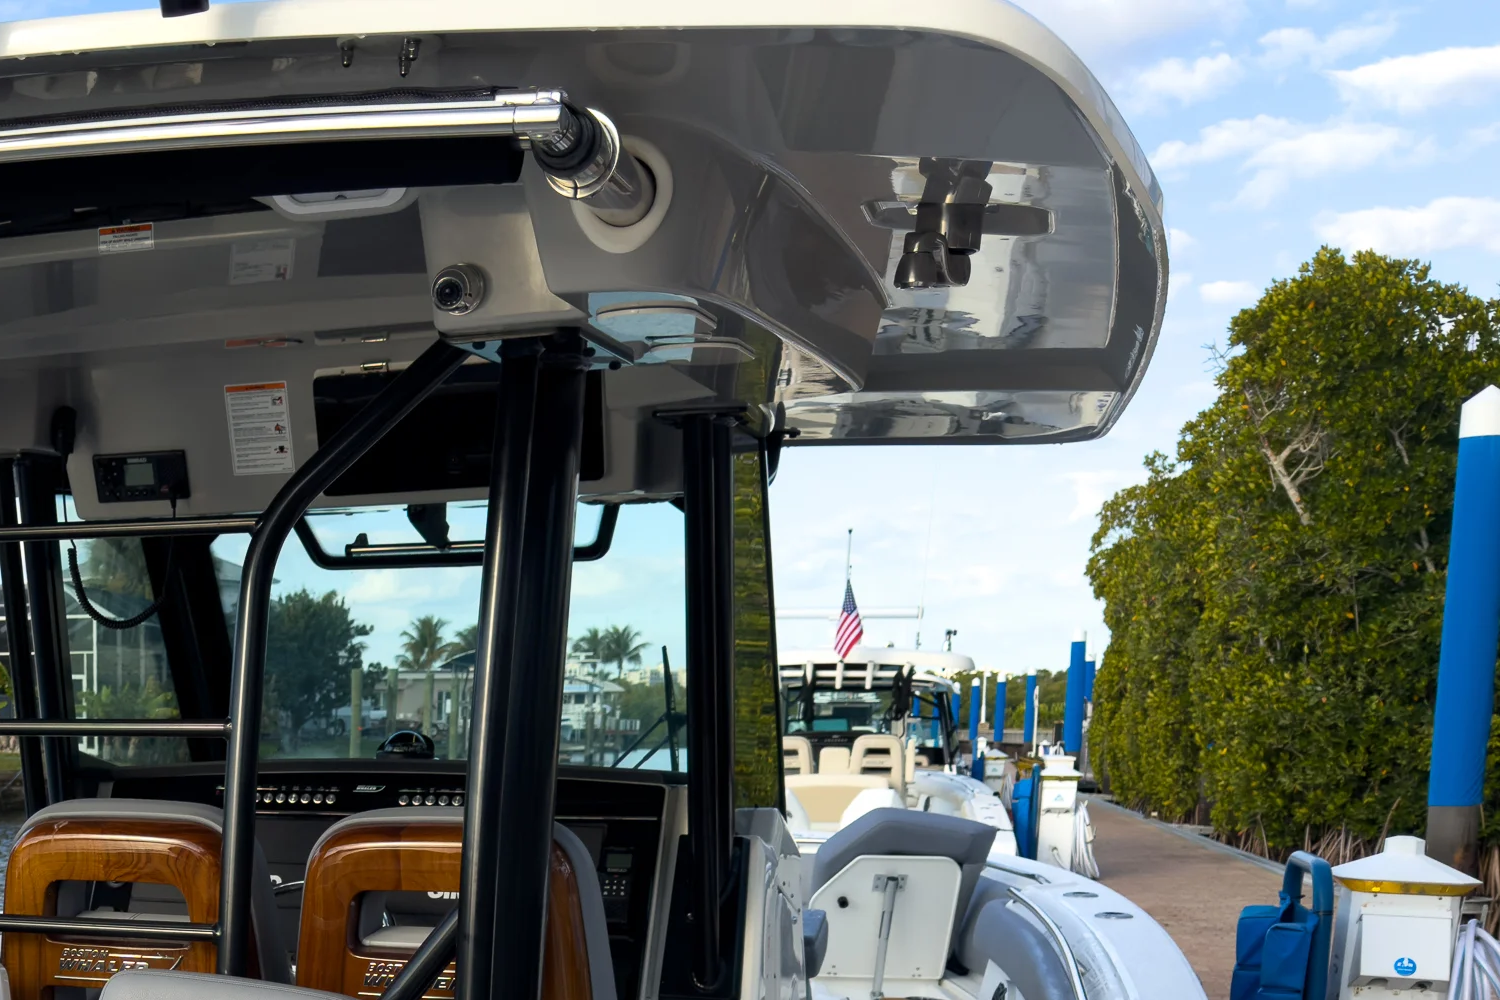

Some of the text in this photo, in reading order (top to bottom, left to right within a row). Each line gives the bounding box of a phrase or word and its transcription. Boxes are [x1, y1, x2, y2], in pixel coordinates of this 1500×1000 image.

[62, 947, 109, 958] BOSTON
[59, 957, 150, 973] WHALER
[367, 962, 403, 972] BOST
